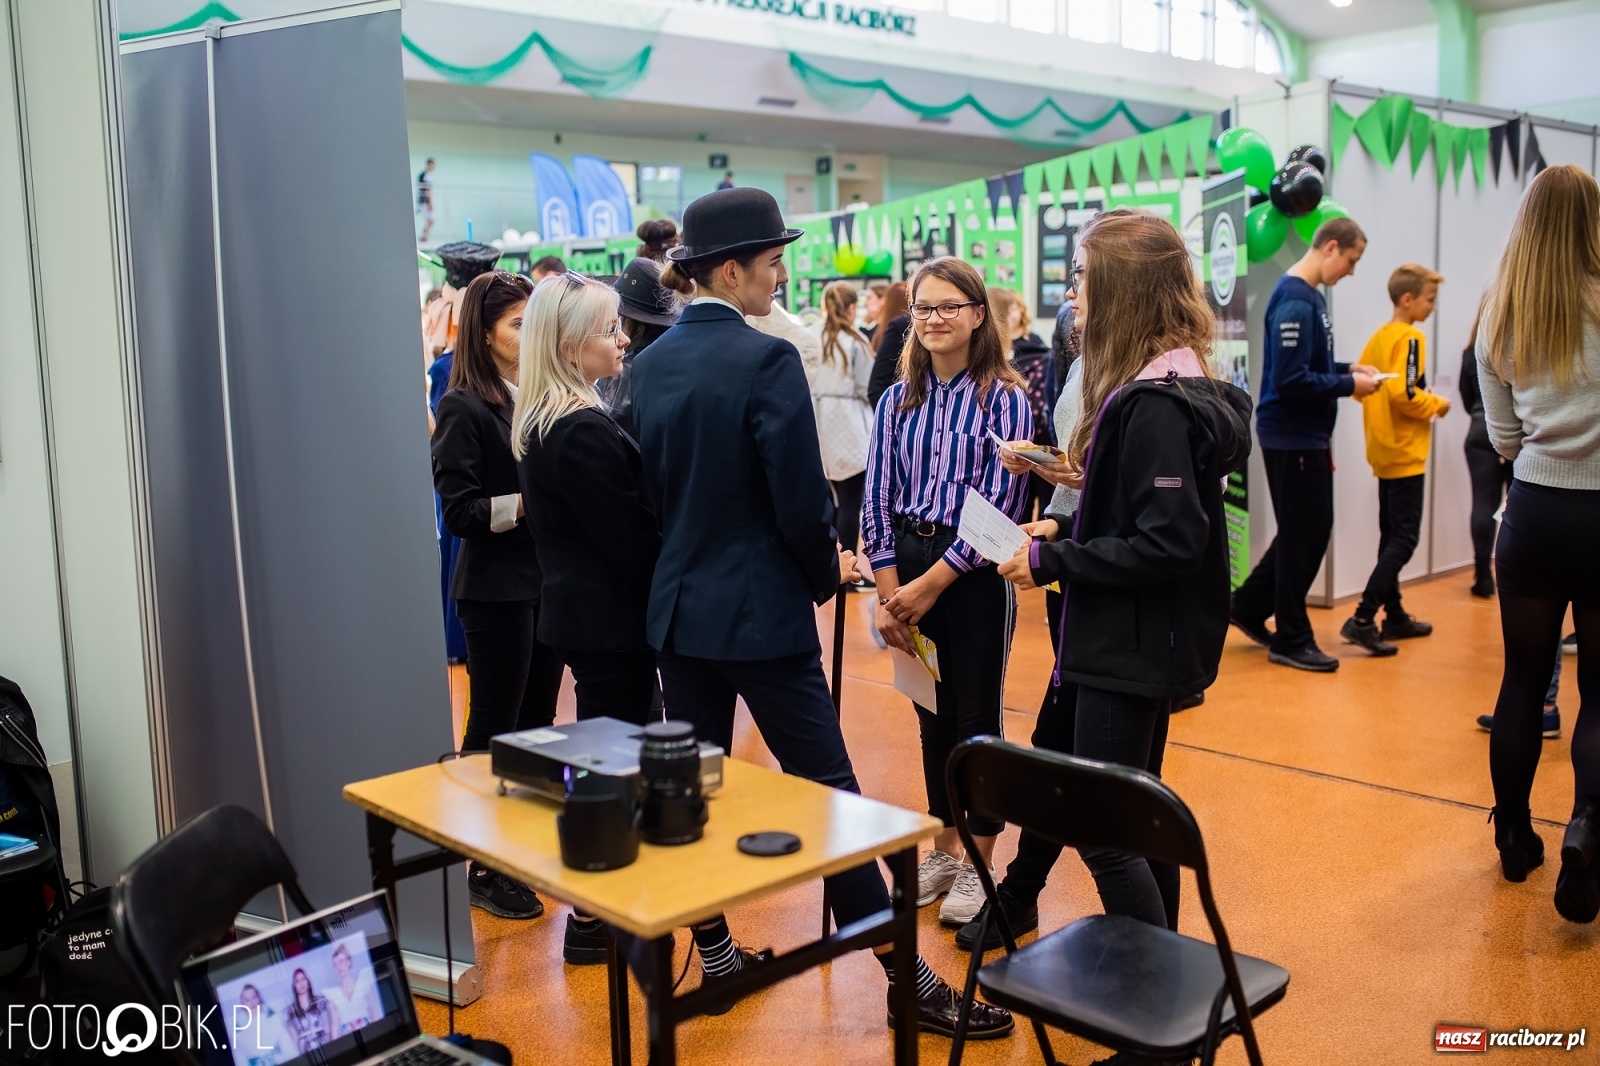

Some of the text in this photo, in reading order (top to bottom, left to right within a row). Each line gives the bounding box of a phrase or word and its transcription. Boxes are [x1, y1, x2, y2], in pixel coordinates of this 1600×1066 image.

[67, 930, 103, 945] jedyne
[82, 941, 106, 951] mam
[68, 951, 93, 960] dość
